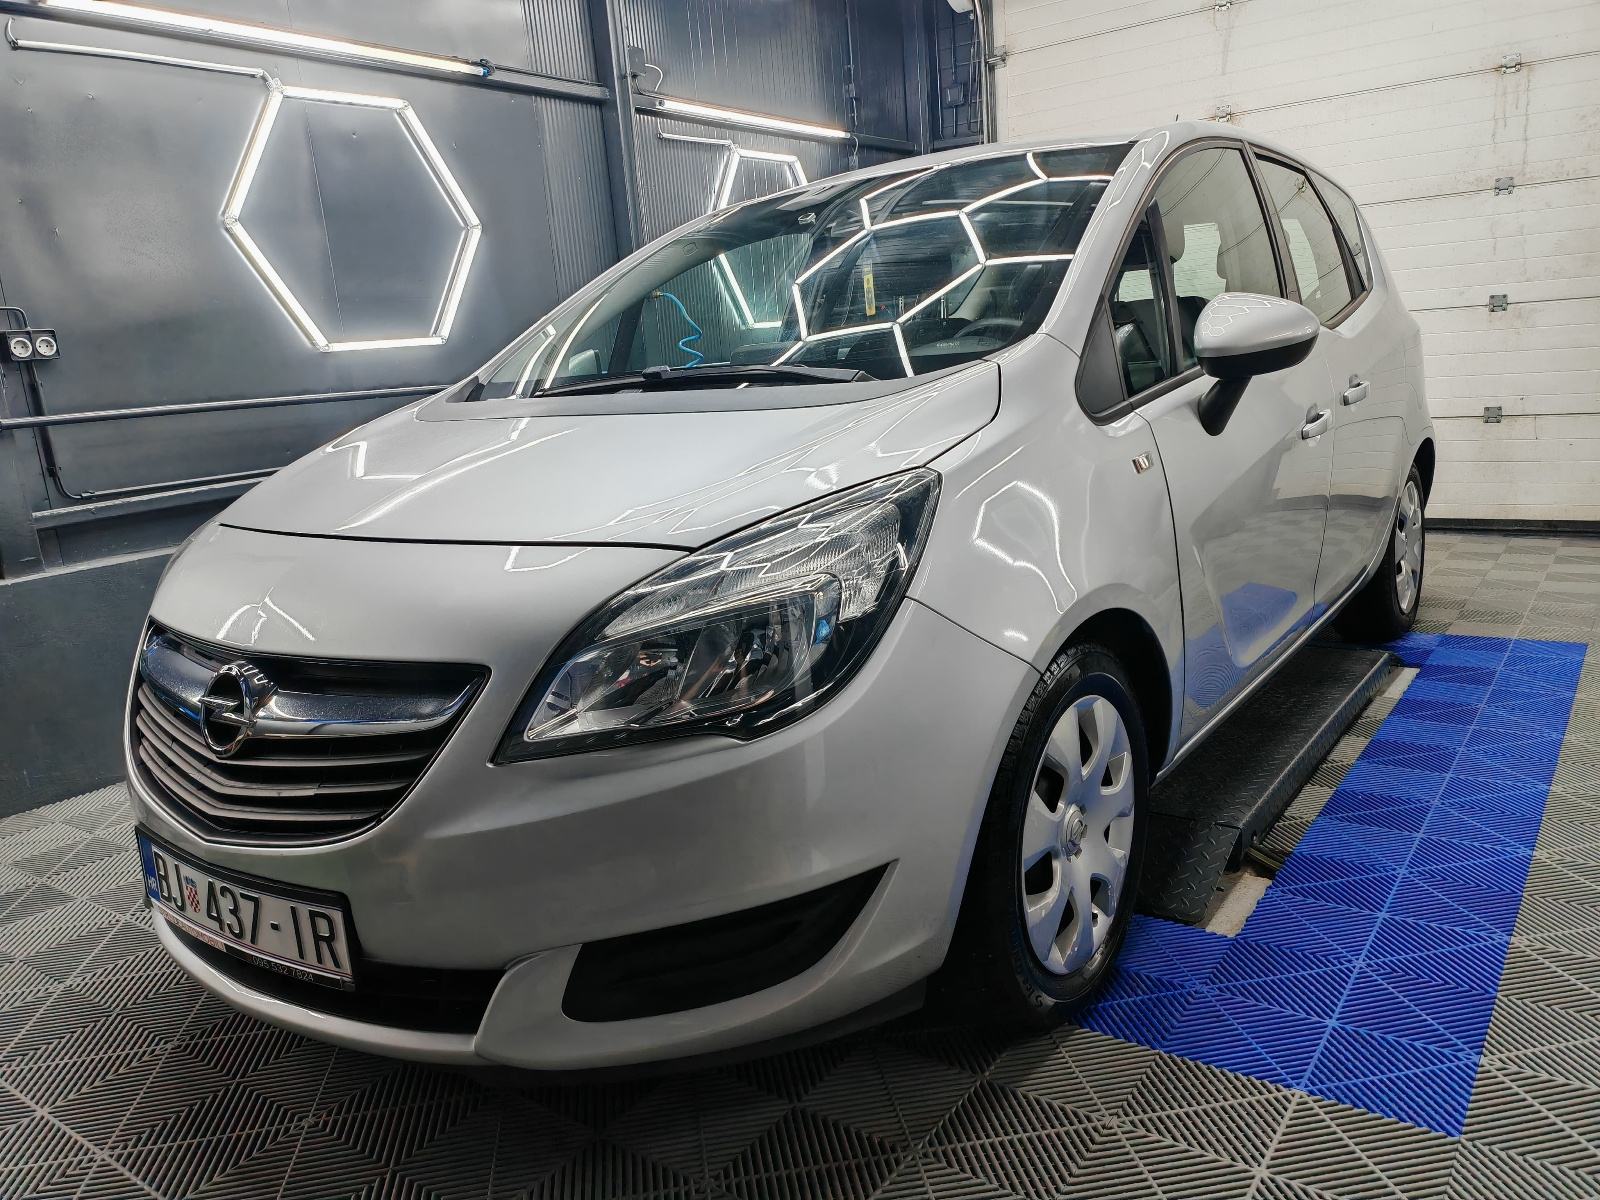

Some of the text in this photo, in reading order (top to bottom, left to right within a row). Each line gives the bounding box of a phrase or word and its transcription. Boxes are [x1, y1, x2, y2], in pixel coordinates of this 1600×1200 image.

[154, 849, 187, 912] BJ
[271, 961, 289, 975] 532
[291, 967, 315, 982] 7824
